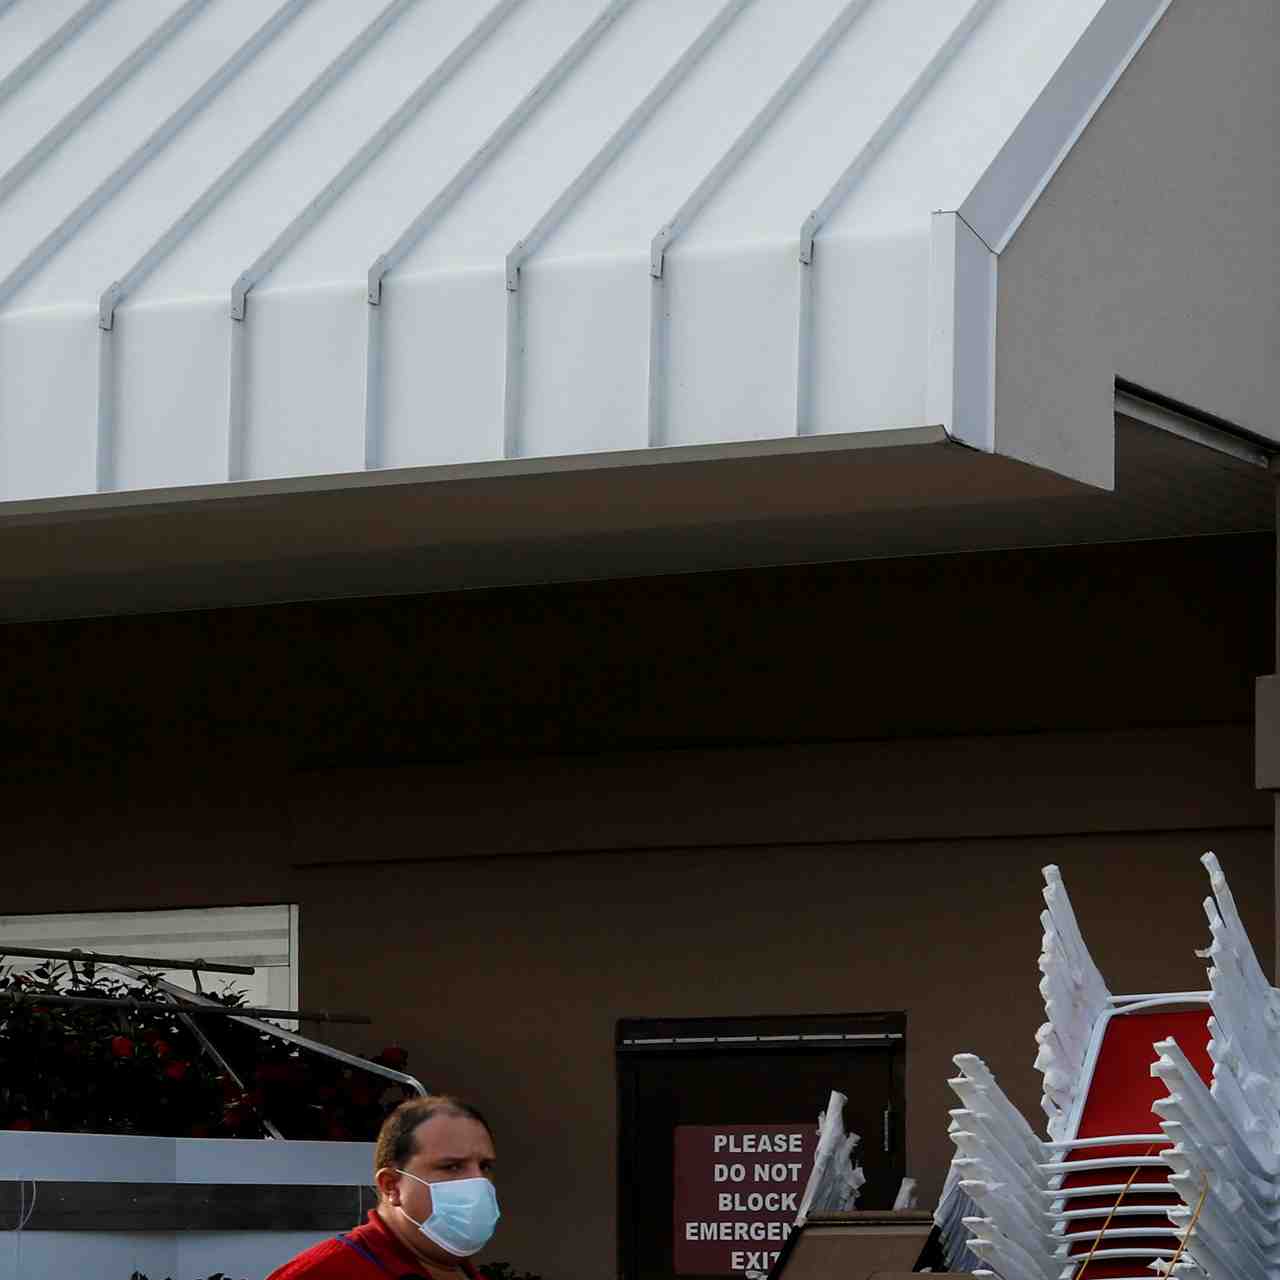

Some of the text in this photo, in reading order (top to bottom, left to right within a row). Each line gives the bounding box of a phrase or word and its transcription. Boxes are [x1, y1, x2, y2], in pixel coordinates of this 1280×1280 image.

[713, 1134, 803, 1153] PLEASE
[714, 1164, 802, 1182] DO NOT
[718, 1193, 798, 1212] BLOCK
[685, 1222, 792, 1240] EMERGEN
